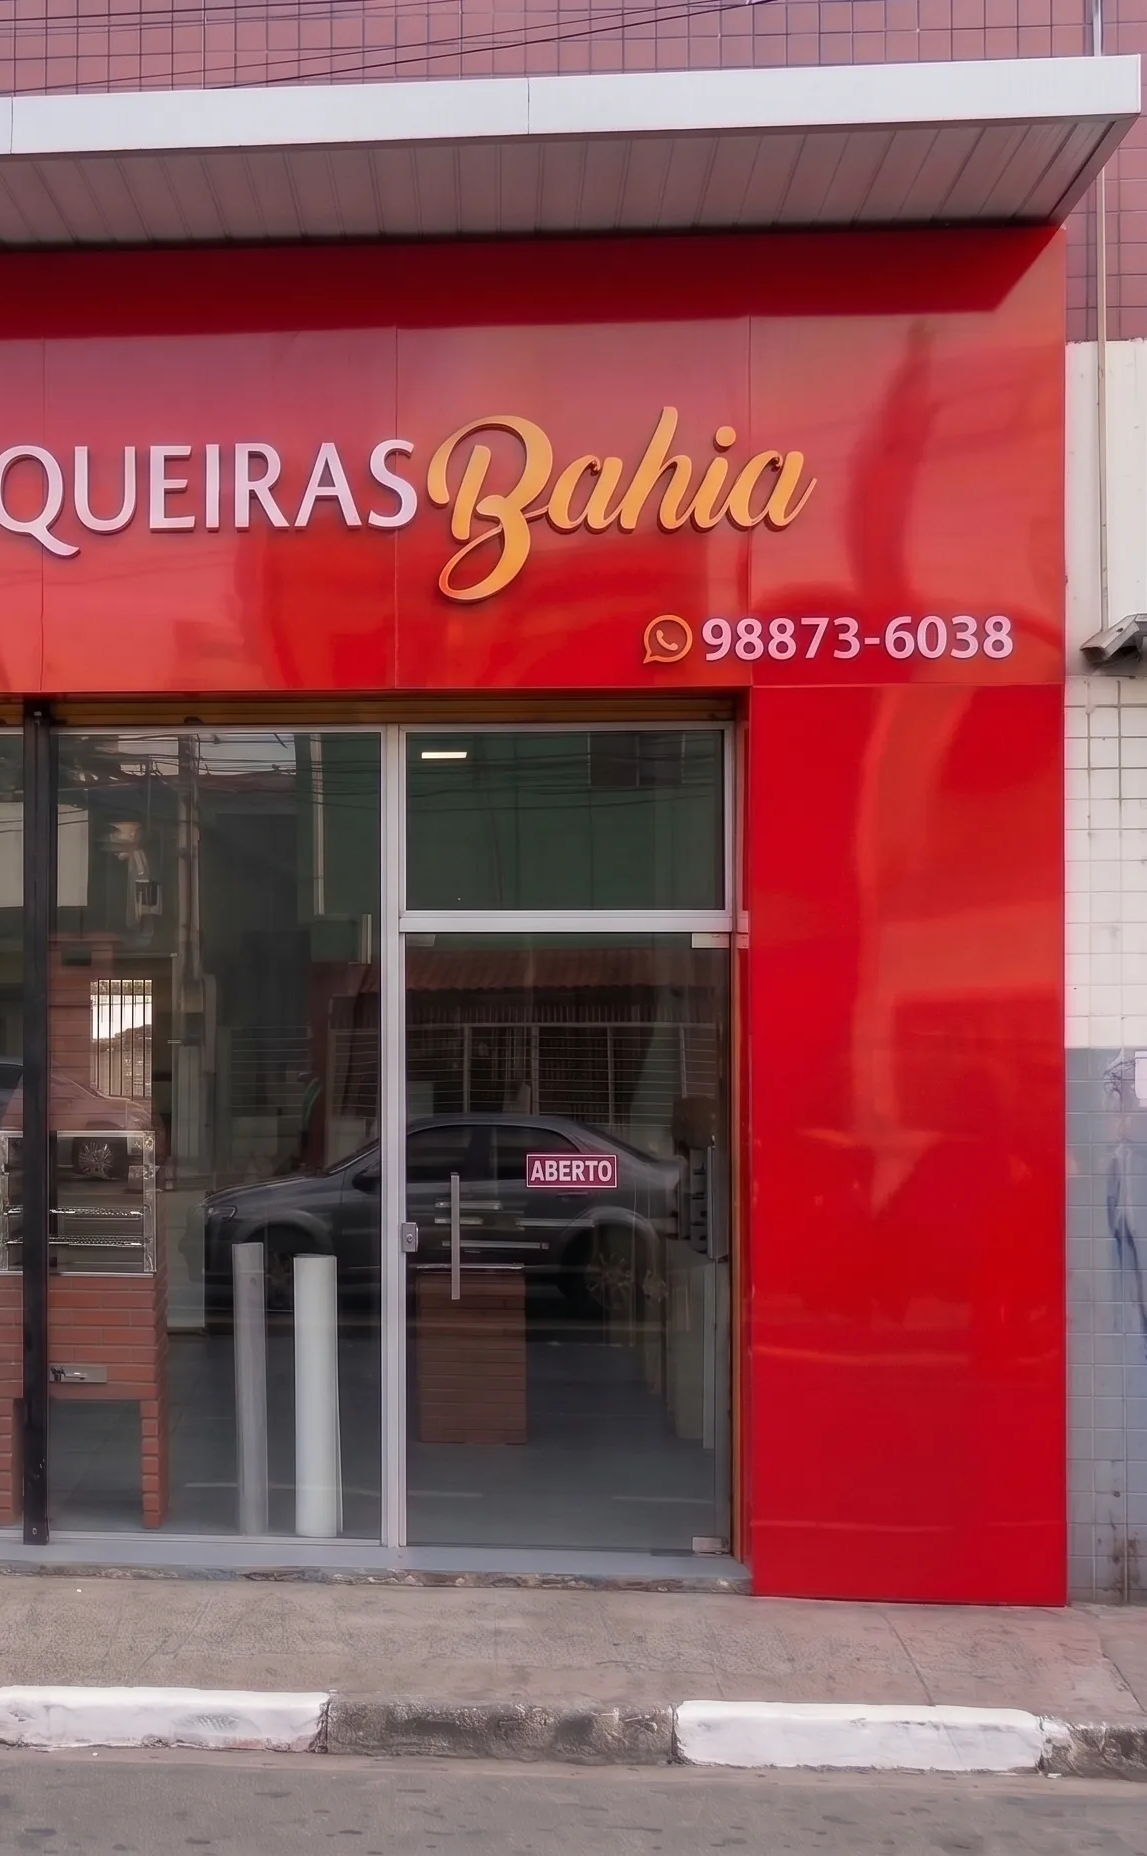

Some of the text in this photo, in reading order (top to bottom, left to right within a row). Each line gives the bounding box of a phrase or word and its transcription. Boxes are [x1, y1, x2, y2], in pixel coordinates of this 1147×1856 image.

[427, 406, 817, 601] Bahia
[701, 615, 1015, 661] 98873-6038
[530, 1160, 612, 1182] ABERTO
